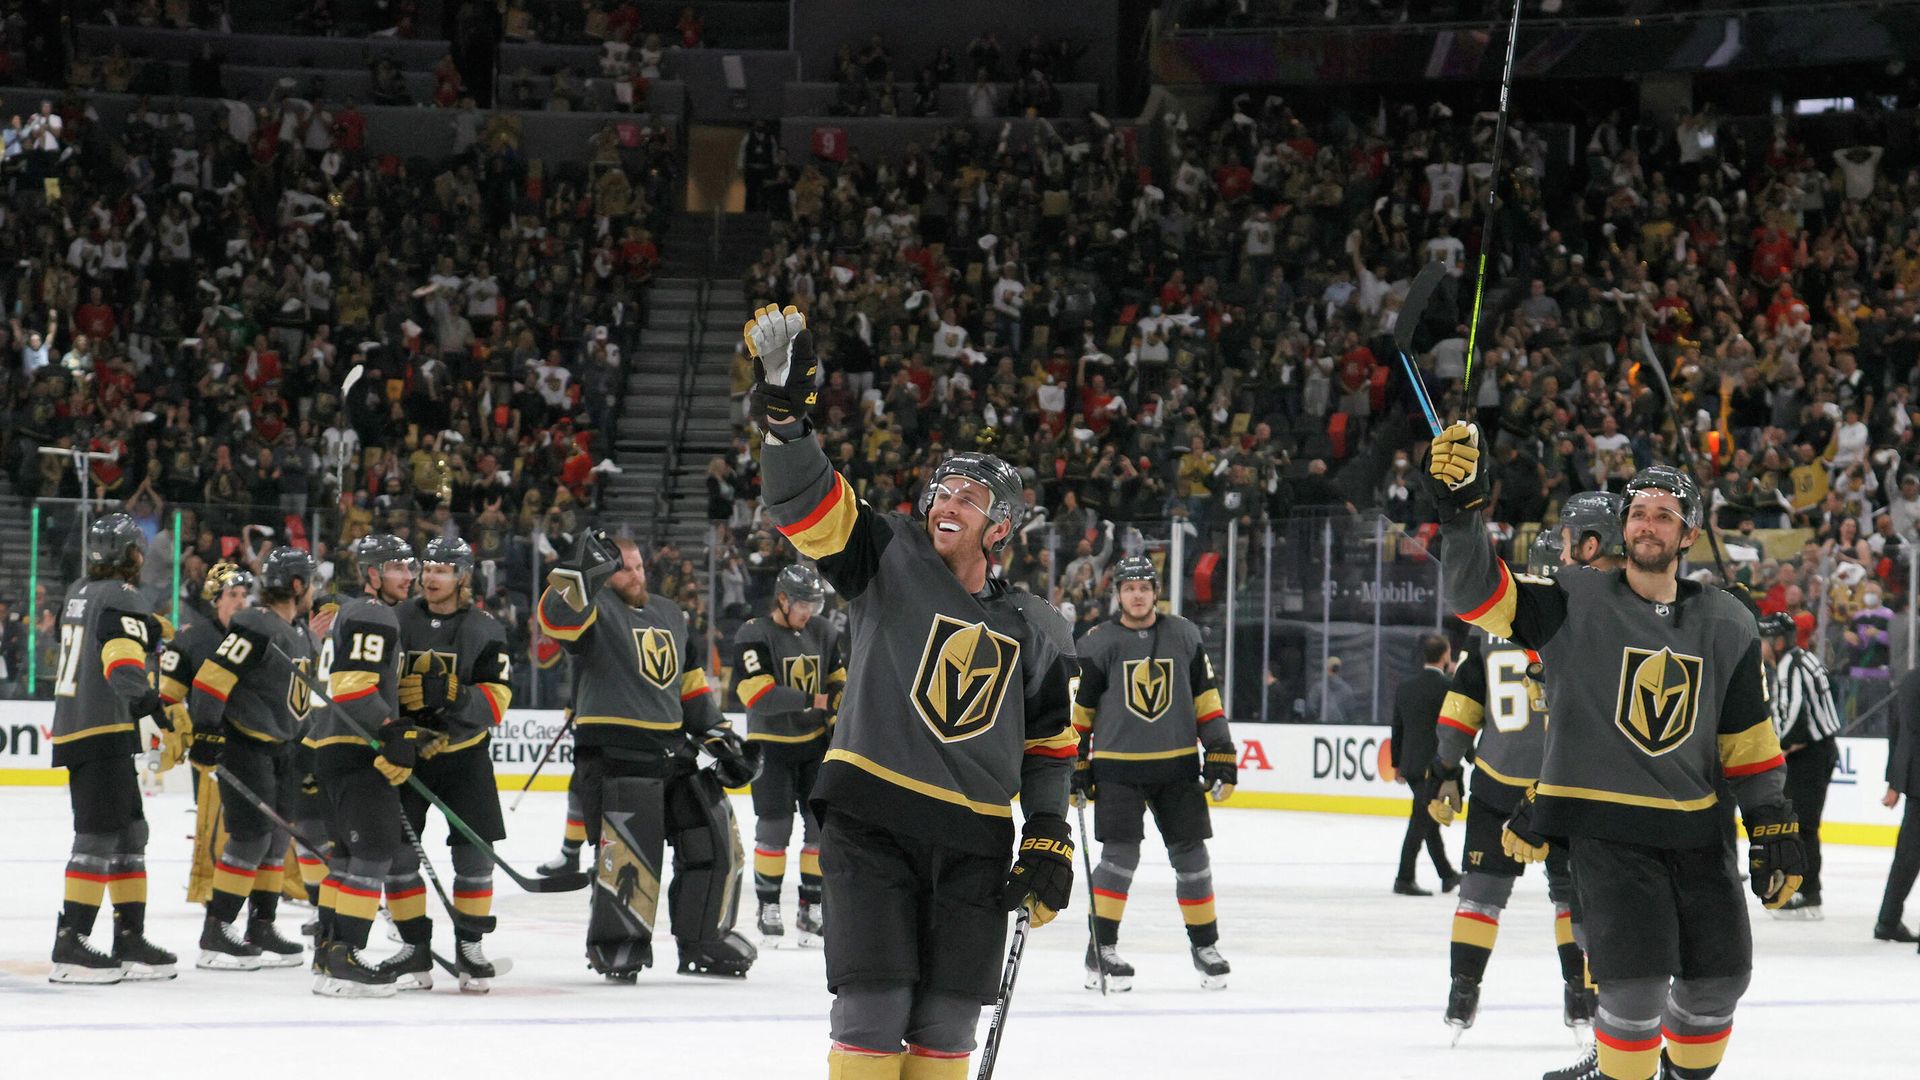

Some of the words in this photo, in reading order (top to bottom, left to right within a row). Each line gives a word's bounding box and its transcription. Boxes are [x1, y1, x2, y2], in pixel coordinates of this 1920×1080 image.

[119, 615, 149, 646] 61
[215, 632, 253, 665] 20
[349, 632, 385, 663] 19
[742, 648, 762, 675] 2
